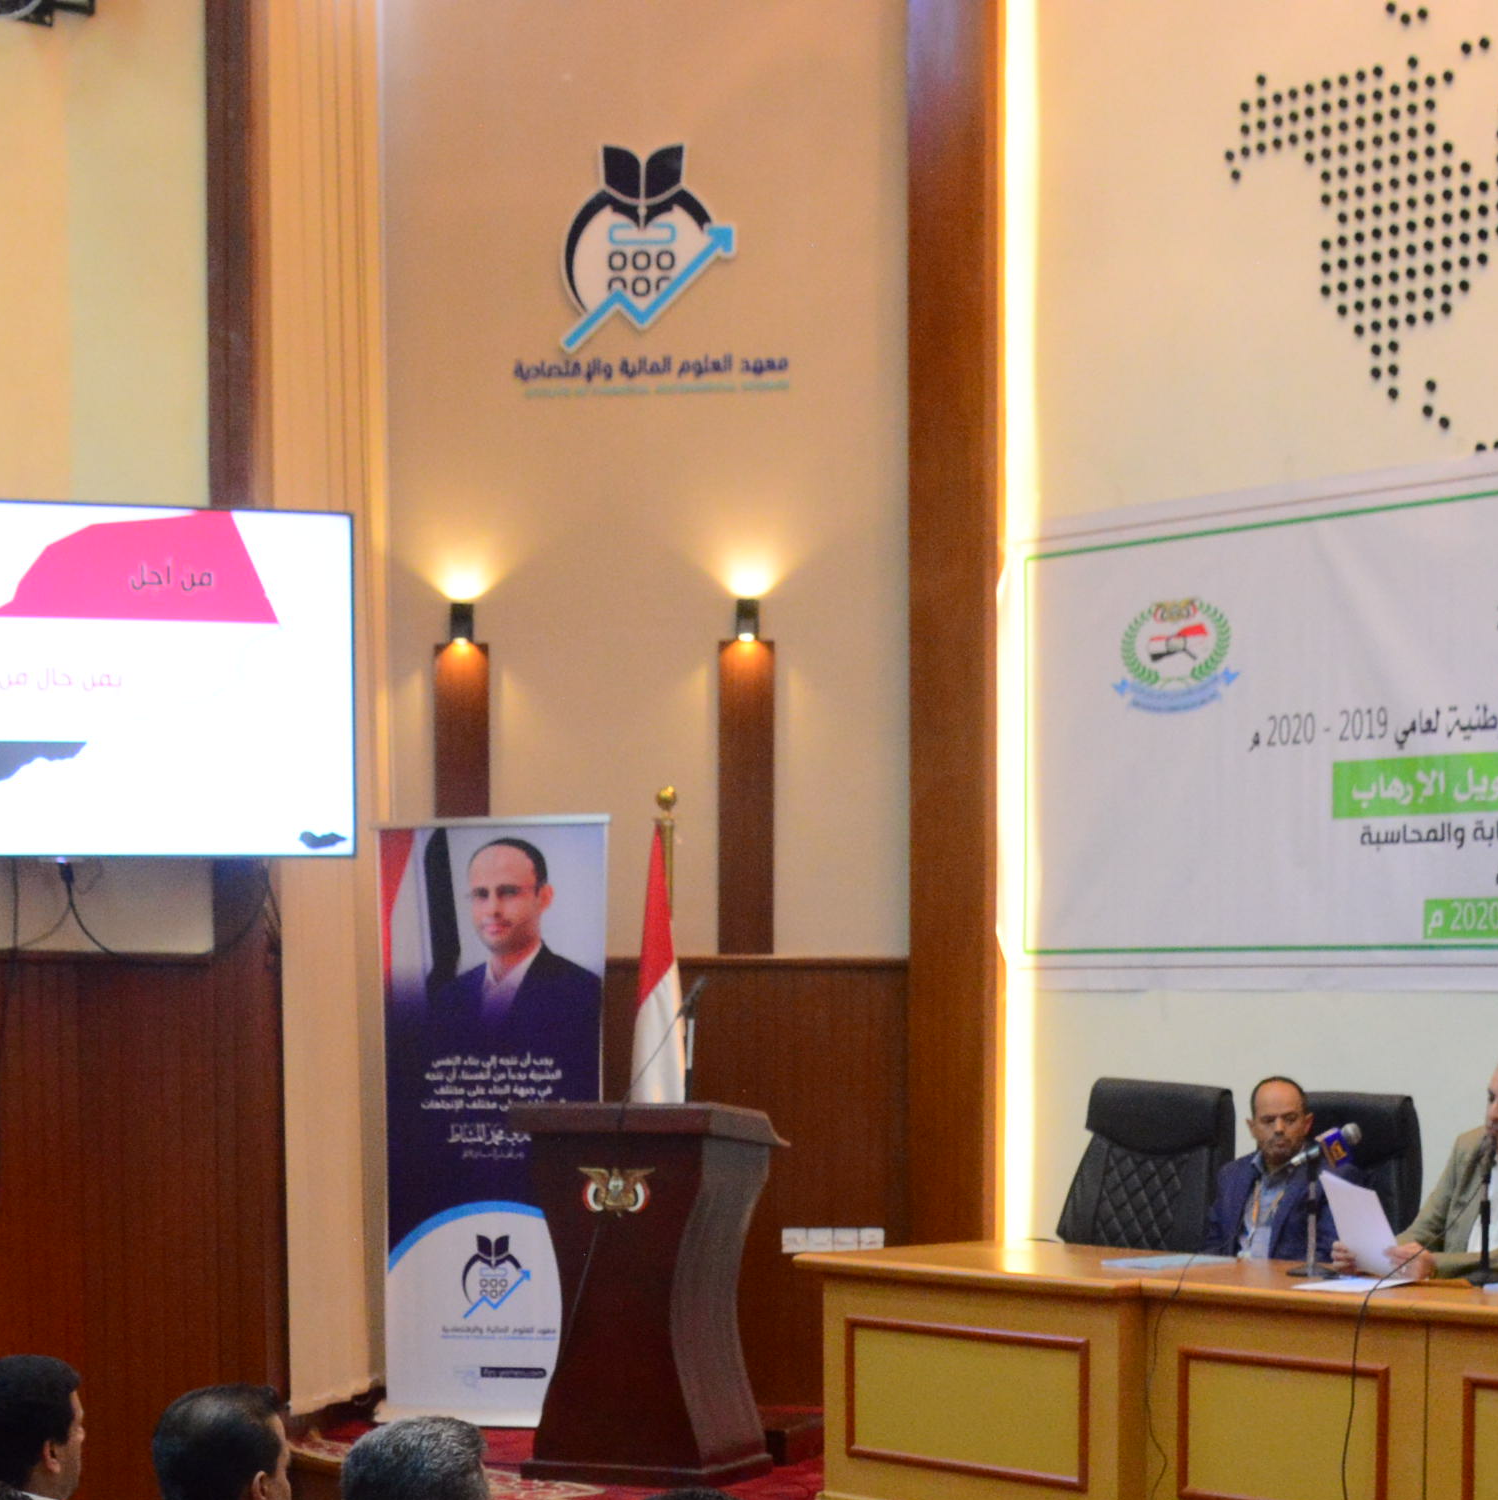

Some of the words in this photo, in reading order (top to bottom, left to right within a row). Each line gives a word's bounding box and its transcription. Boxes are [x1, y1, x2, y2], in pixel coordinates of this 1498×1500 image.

[618, 355, 671, 379] المالية
[677, 353, 733, 378] العلوم
[740, 356, 789, 376] معهد
[1266, 713, 1316, 746] 2020
[1338, 707, 1389, 742] 2019
[1394, 708, 1441, 751] لعامي
[1359, 821, 1466, 853] والمحاسبة
